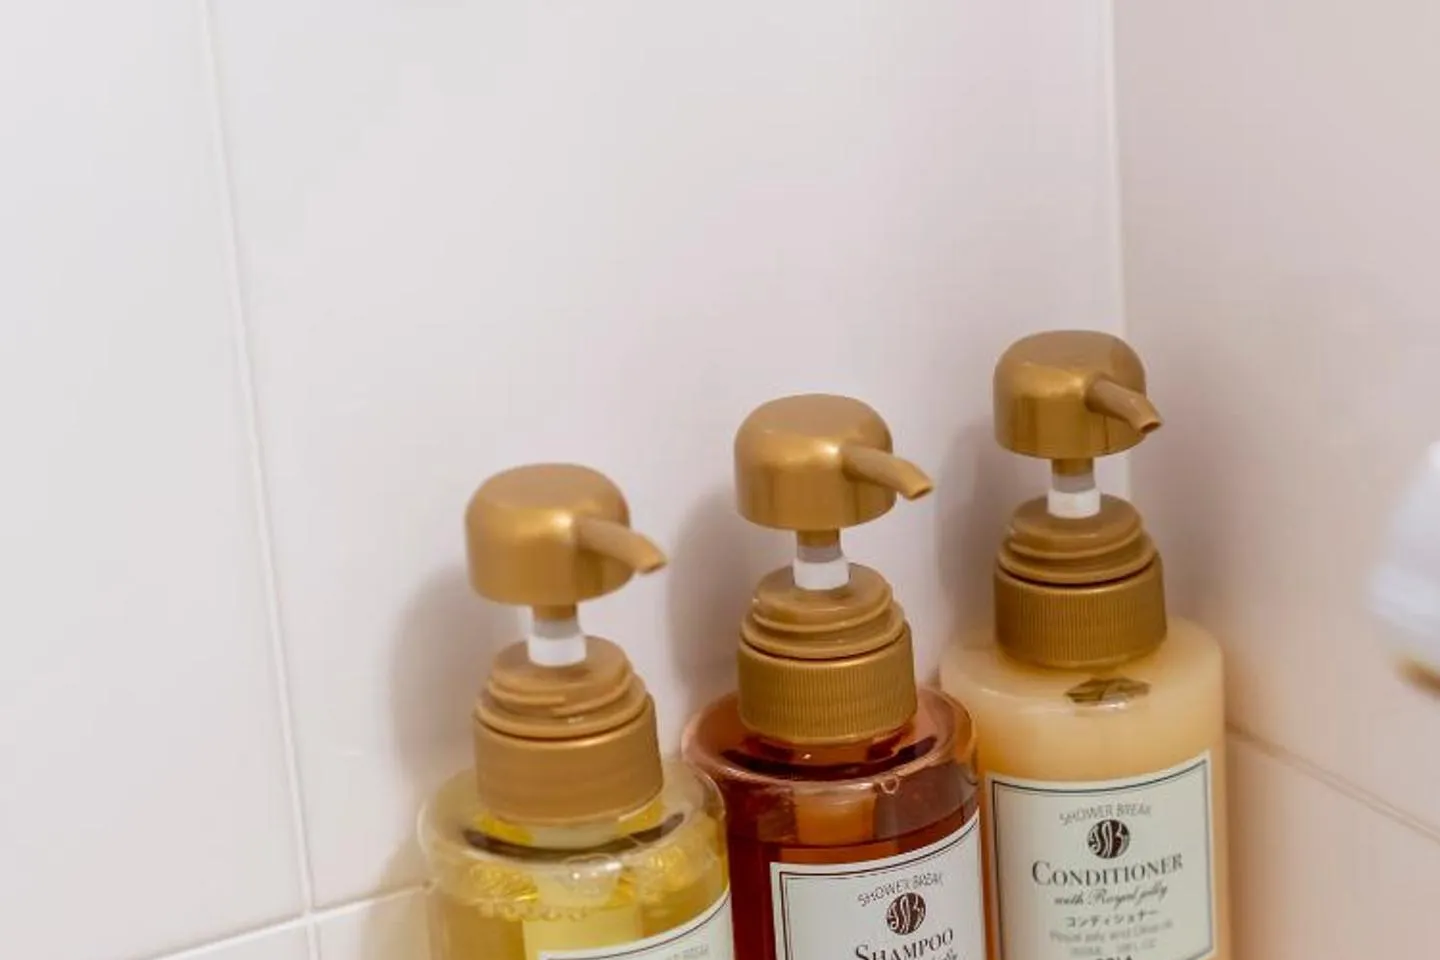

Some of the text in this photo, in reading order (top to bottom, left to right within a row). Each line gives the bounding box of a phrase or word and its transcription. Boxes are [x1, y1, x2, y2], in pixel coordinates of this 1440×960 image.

[1058, 805, 1114, 825] SHOWER
[1032, 853, 1183, 886] CONDITIONER
[858, 880, 910, 907] SHOWER
